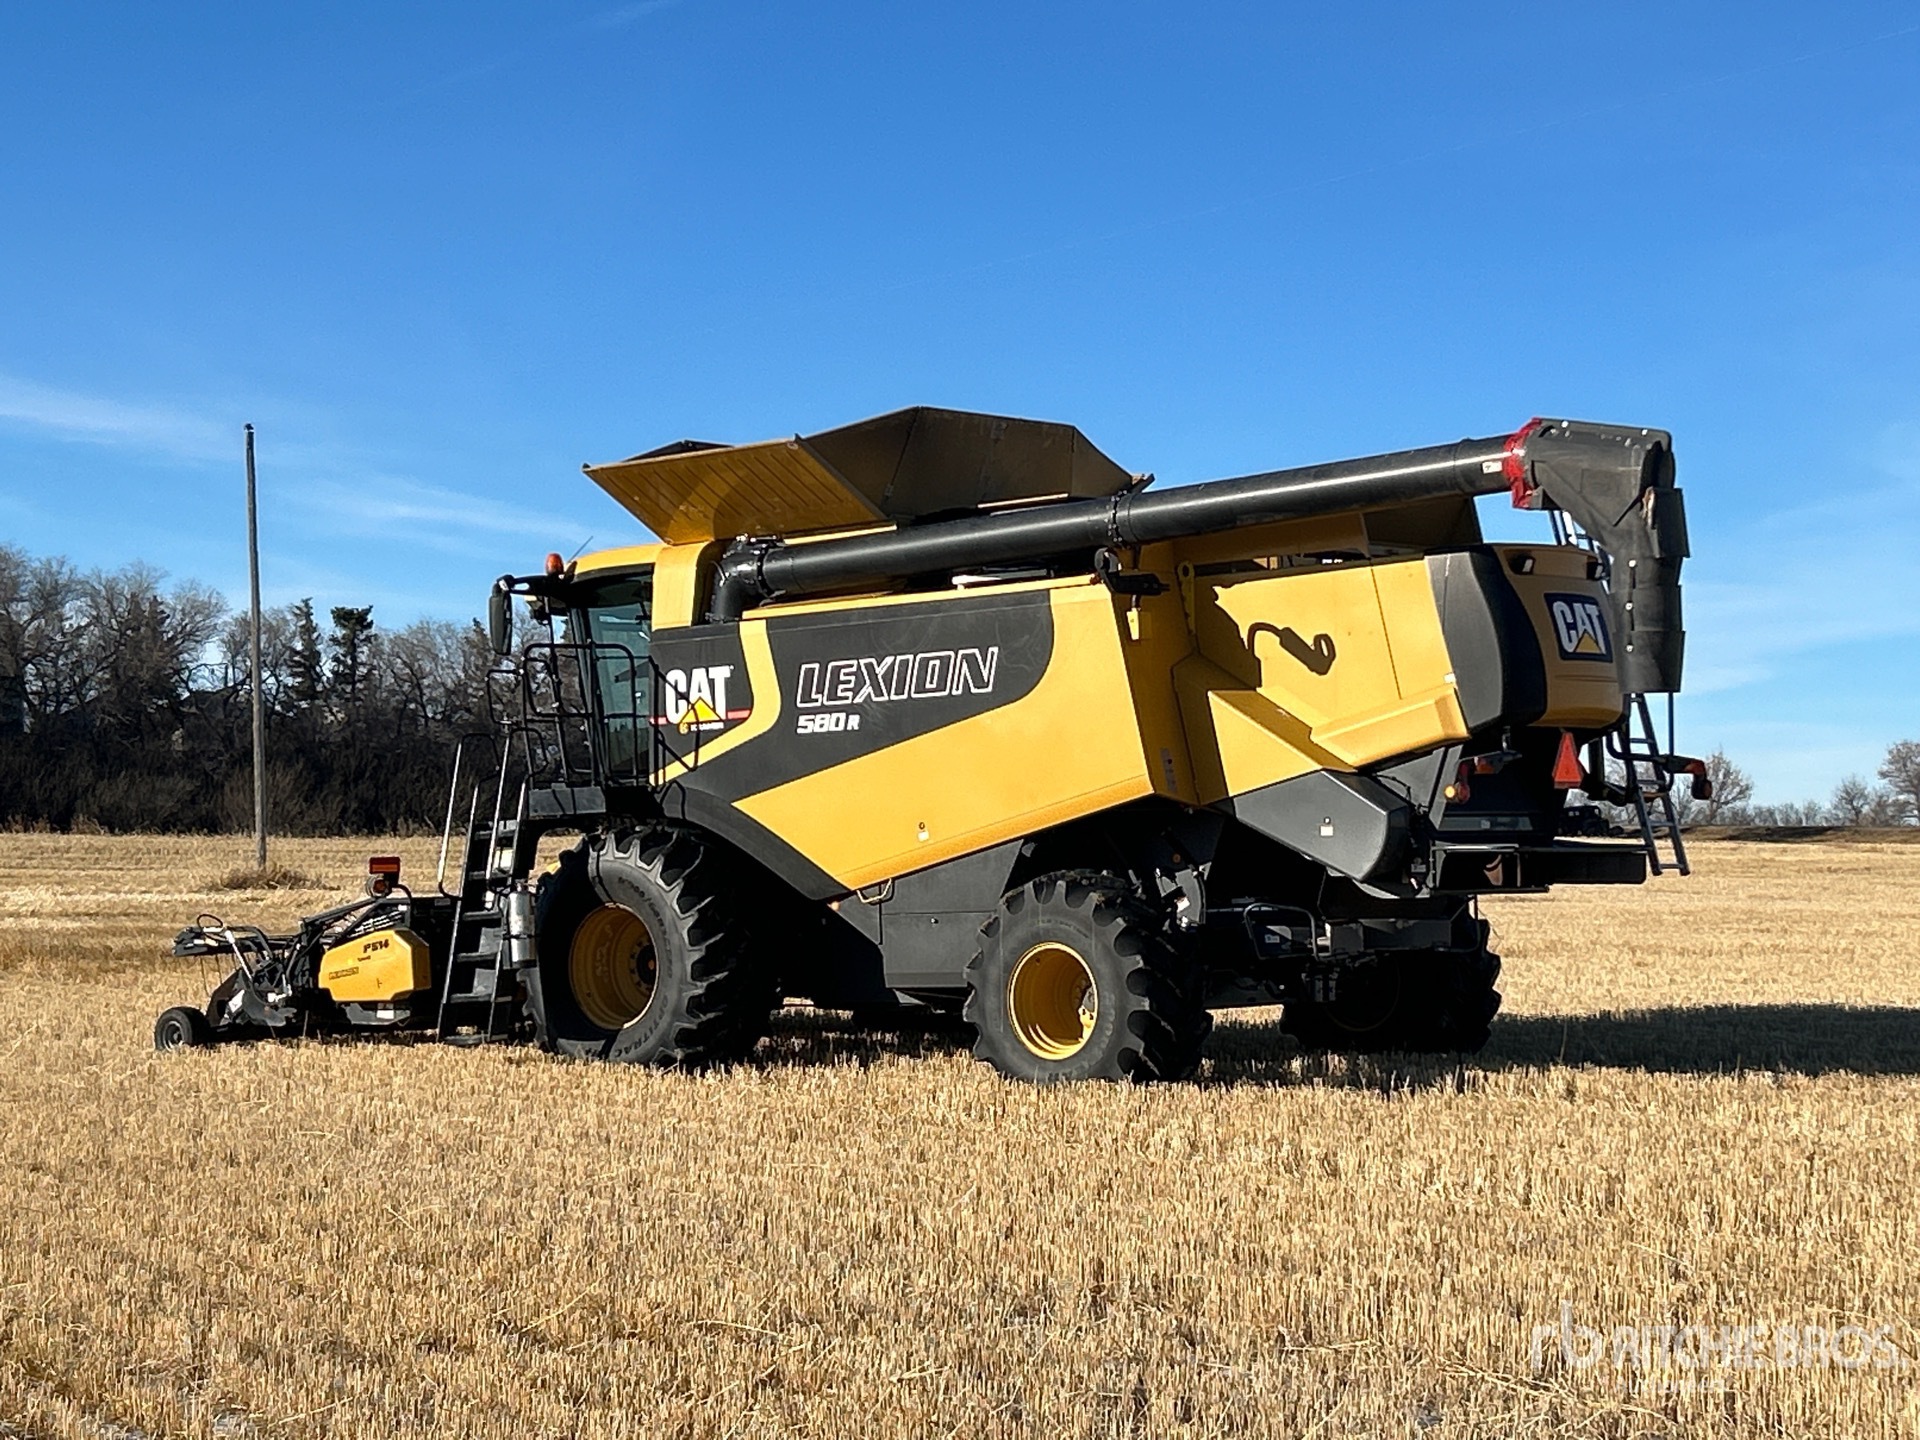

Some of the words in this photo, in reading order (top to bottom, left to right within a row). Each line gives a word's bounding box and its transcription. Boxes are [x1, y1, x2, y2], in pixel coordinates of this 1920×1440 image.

[1553, 601, 1607, 655] CAT
[665, 665, 731, 725] CAT
[797, 646, 999, 708] LEXION
